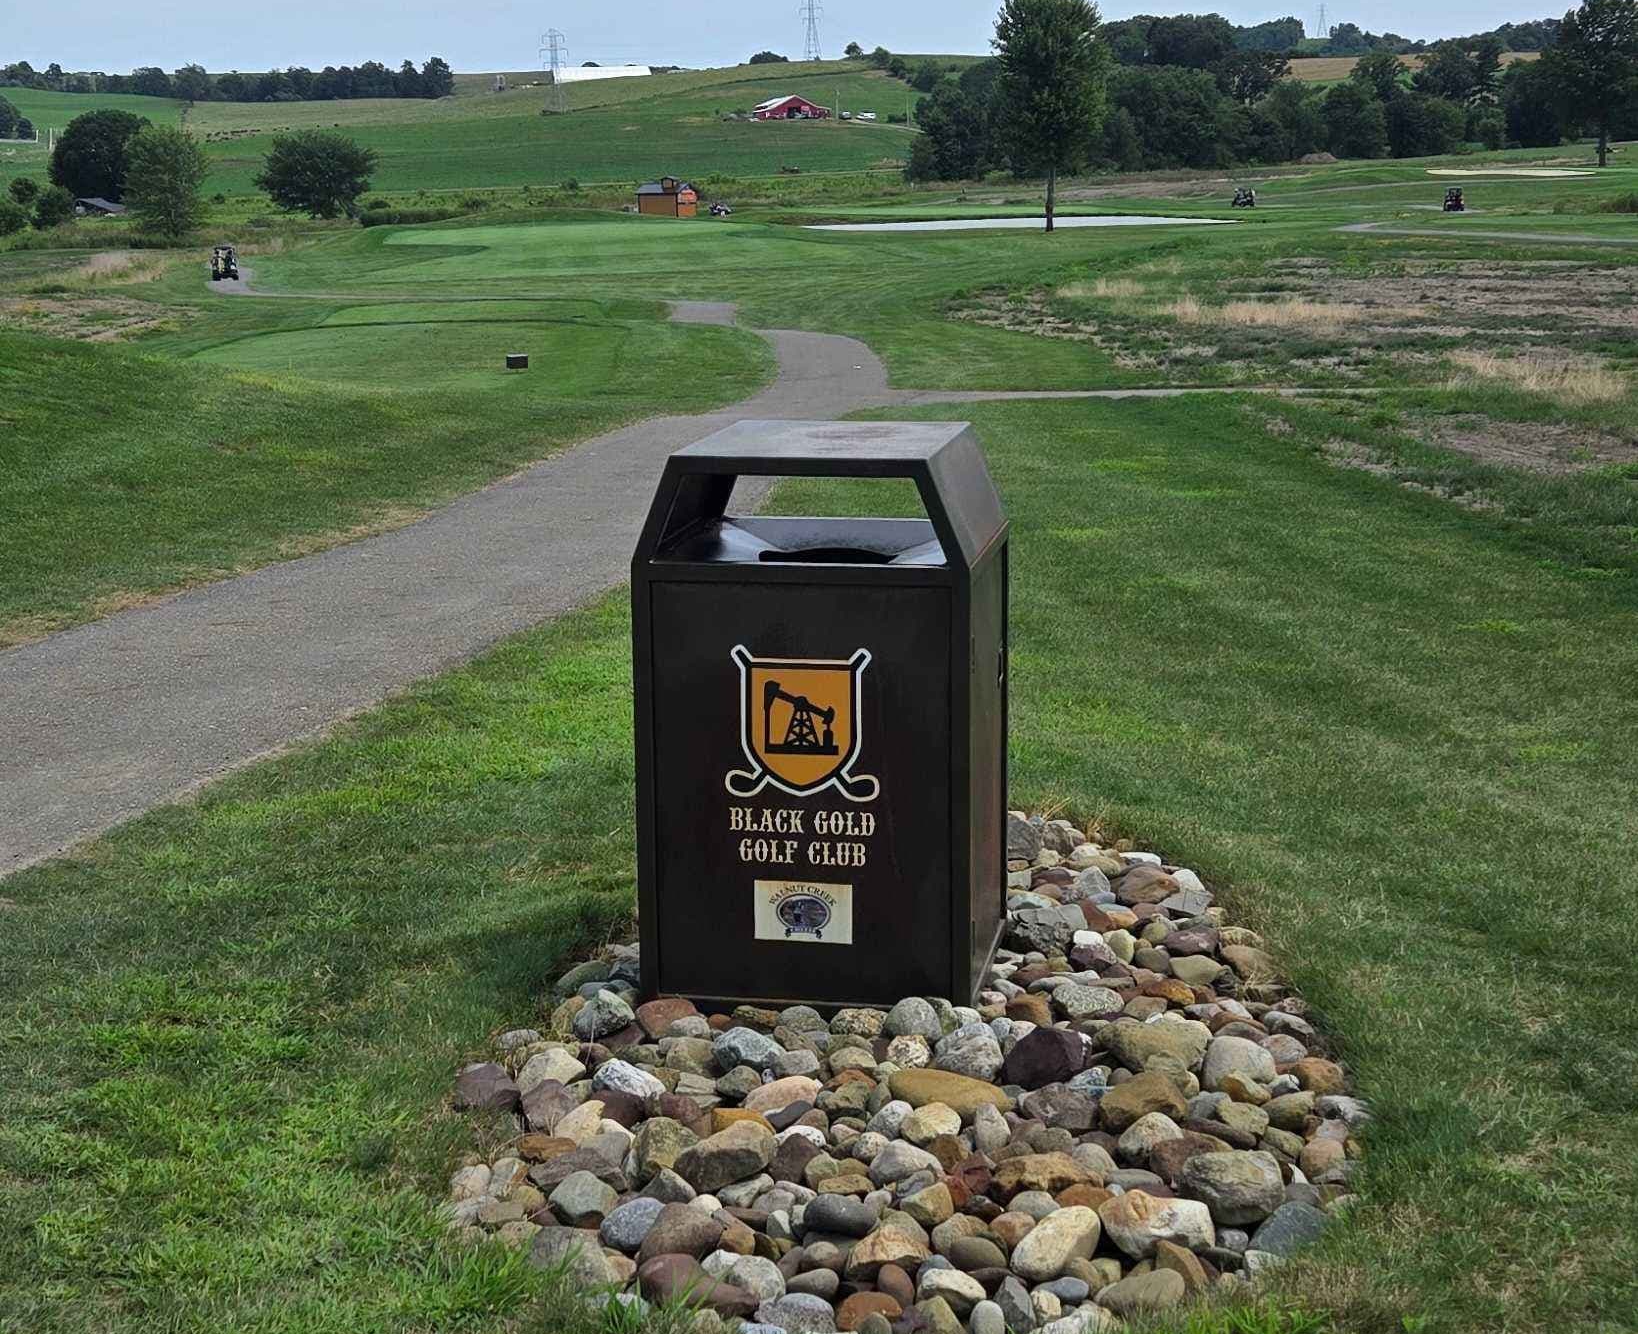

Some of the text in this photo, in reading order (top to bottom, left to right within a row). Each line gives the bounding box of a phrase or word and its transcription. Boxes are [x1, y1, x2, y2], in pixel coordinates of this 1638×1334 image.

[729, 807, 876, 836] BLACK GOLD
[738, 838, 866, 867] GOLF CLUB
[769, 884, 837, 907] WALNUT CREEK
